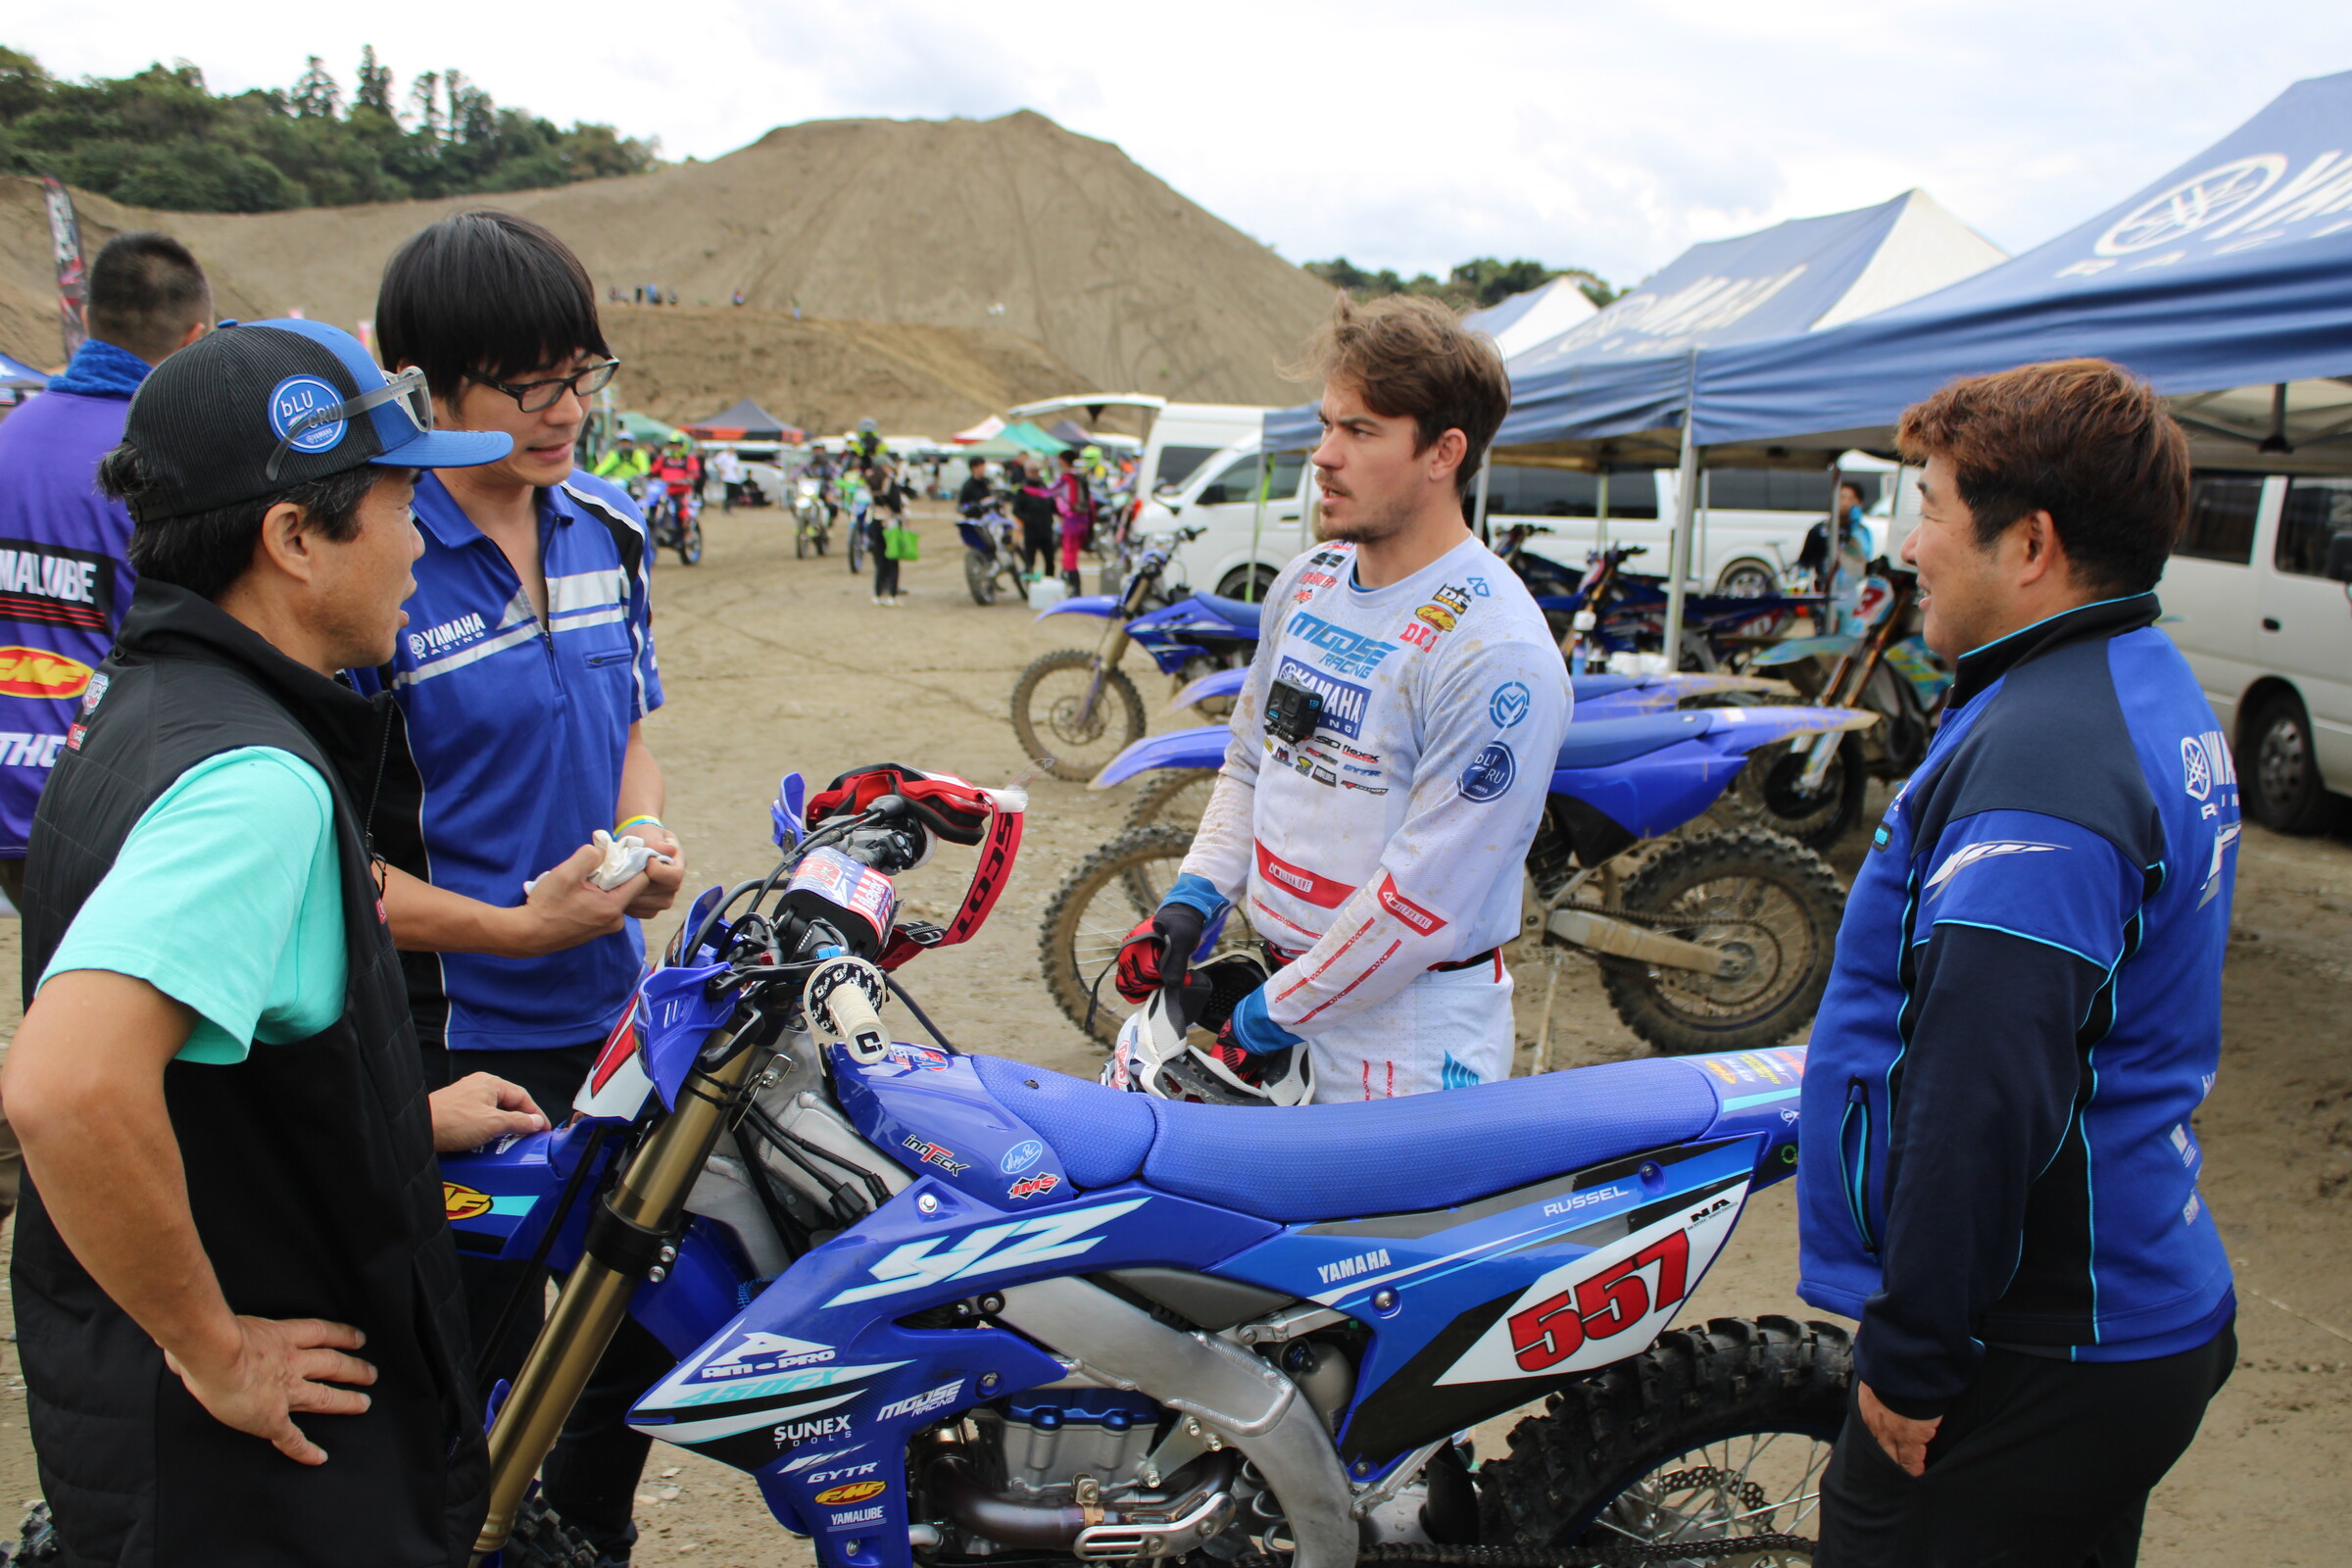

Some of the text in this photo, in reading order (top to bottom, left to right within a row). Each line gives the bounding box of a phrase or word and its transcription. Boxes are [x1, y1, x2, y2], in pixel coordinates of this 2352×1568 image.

[421, 612, 487, 650] YAMAHA
[1286, 611, 1400, 667] MOOSE
[417, 631, 485, 661] RACING
[1318, 652, 1374, 680] RACING
[1396, 904, 1431, 929] ALPHA ONE
[1012, 1175, 1057, 1196] IMS
[1543, 1186, 1629, 1217] RUSSEL
[1690, 1199, 1731, 1223] NA
[820, 1197, 1152, 1309] YZ
[1317, 1249, 1392, 1285] YAMAHA
[1507, 1227, 1690, 1373] 557
[876, 1378, 965, 1422] MOOSE
[910, 1395, 956, 1418] RACING
[774, 1414, 852, 1442] SUNEX
[775, 1431, 852, 1449] TOOLS
[807, 1462, 878, 1484] GYTR
[815, 1481, 886, 1503] FMF
[831, 1505, 885, 1526] YAMALUBE
